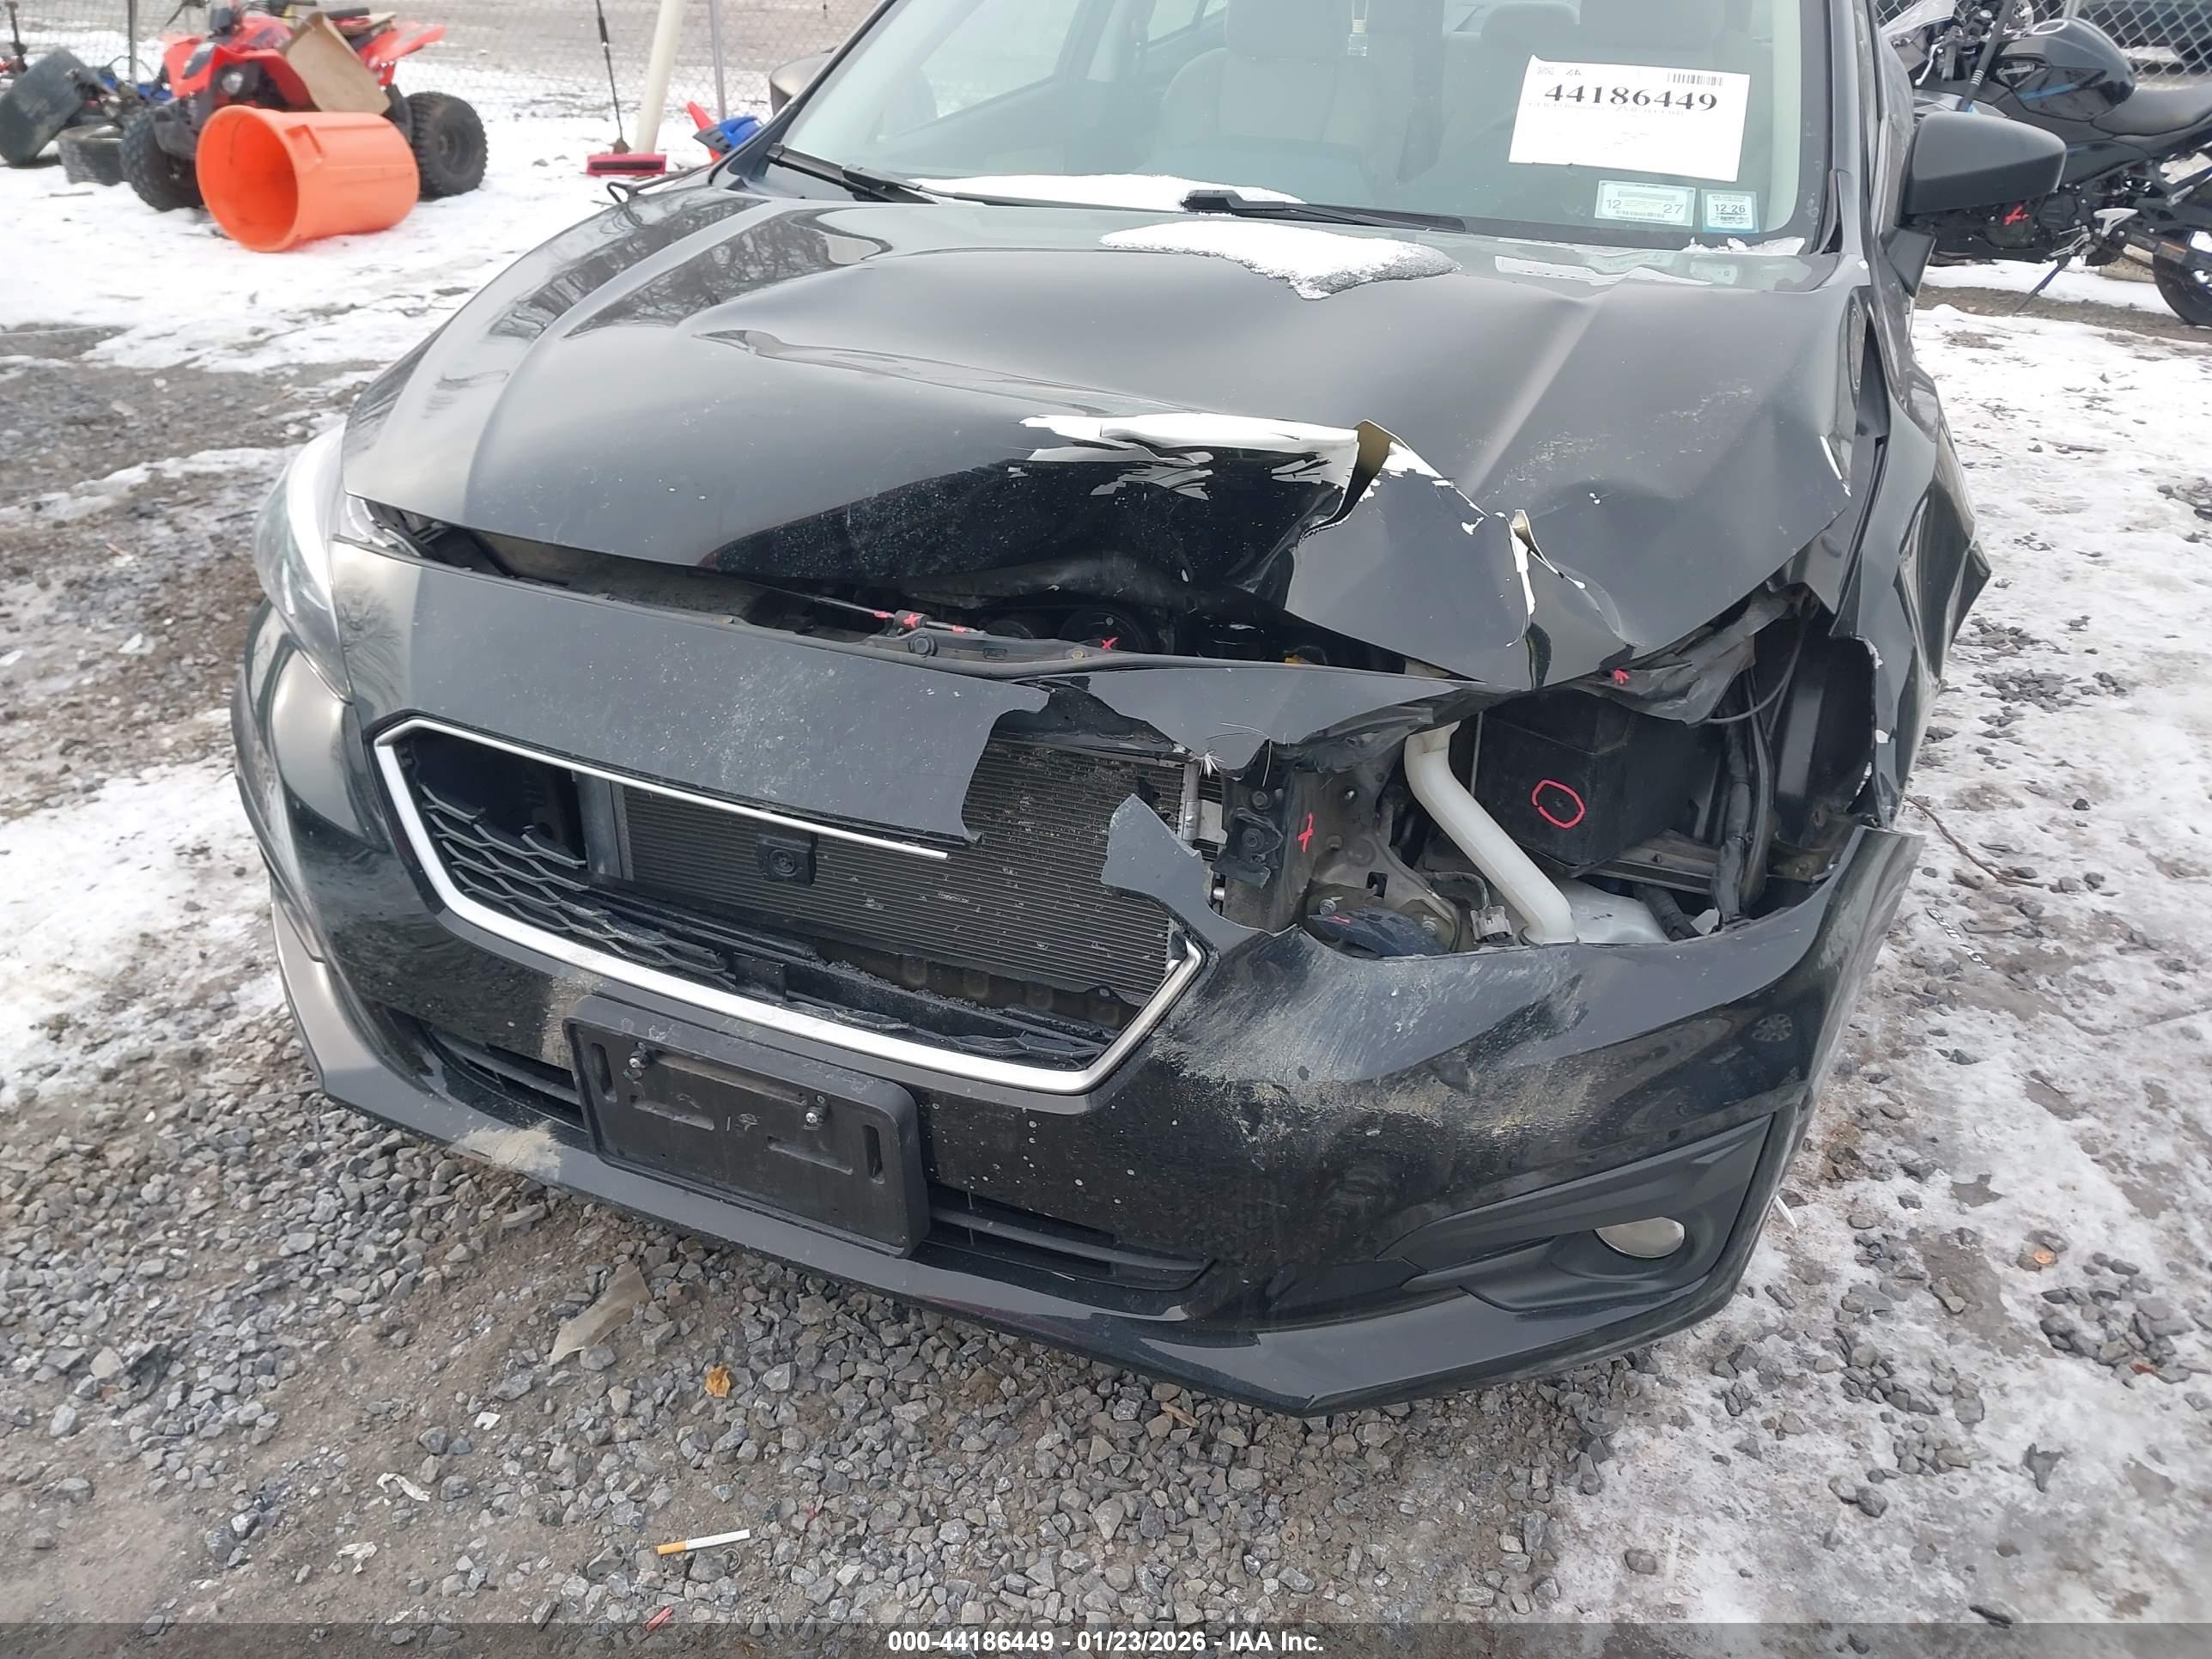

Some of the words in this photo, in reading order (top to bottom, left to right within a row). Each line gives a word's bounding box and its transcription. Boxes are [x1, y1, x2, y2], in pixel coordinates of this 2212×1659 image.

[1544, 84, 1717, 112] 44186449
[1606, 199, 1622, 210] 12
[1663, 204, 1685, 214] 27
[1714, 204, 1727, 212] 12
[1731, 204, 1746, 213] 26
